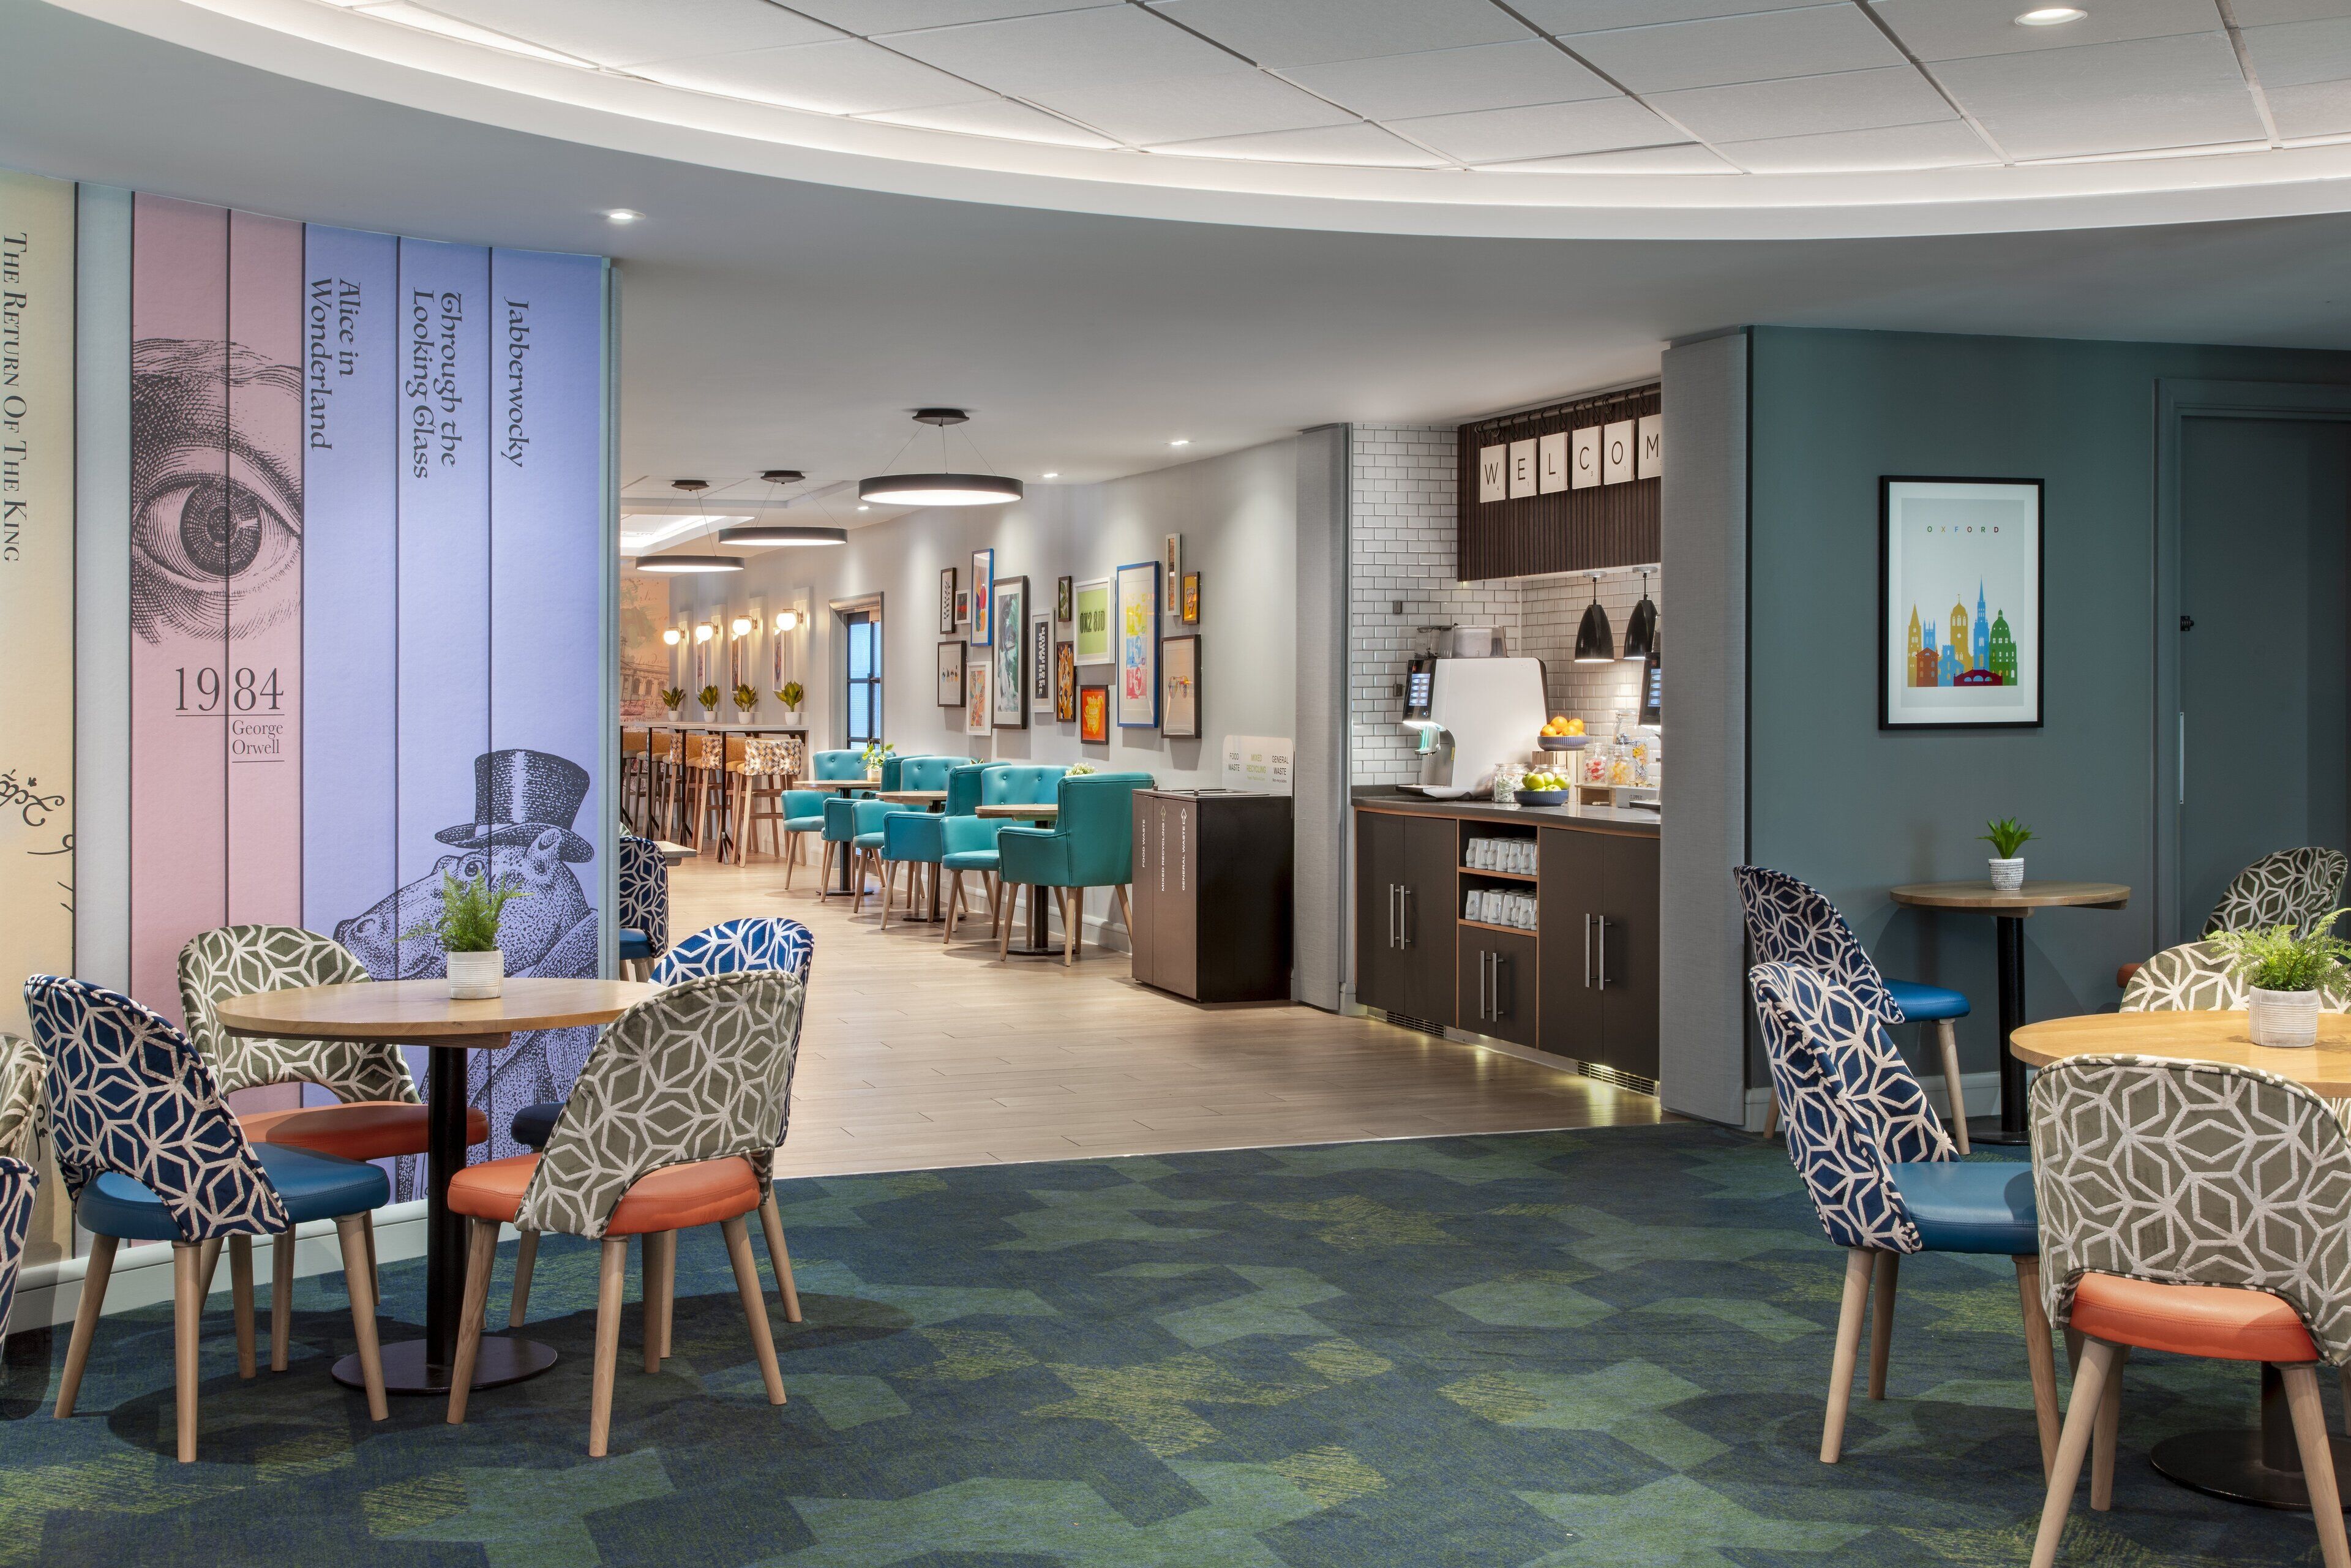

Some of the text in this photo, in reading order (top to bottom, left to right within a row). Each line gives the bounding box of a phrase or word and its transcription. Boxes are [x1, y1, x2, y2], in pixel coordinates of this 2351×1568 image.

[339, 277, 361, 378] Alice in
[310, 277, 332, 452] Wonderland
[405, 287, 437, 479] Looking Glass
[433, 292, 463, 468] Through the
[500, 296, 530, 468] Jabberwocky
[3, 233, 28, 563] THE RETURN OF THE KING
[1485, 433, 1659, 485] WELCOM
[176, 667, 284, 711] 1984
[232, 719, 283, 739] George
[232, 739, 280, 754] Orwell
[1247, 765, 1267, 774] RECYCLING
[1272, 755, 1289, 764] GENERAL
[1273, 767, 1286, 775] WASTE
